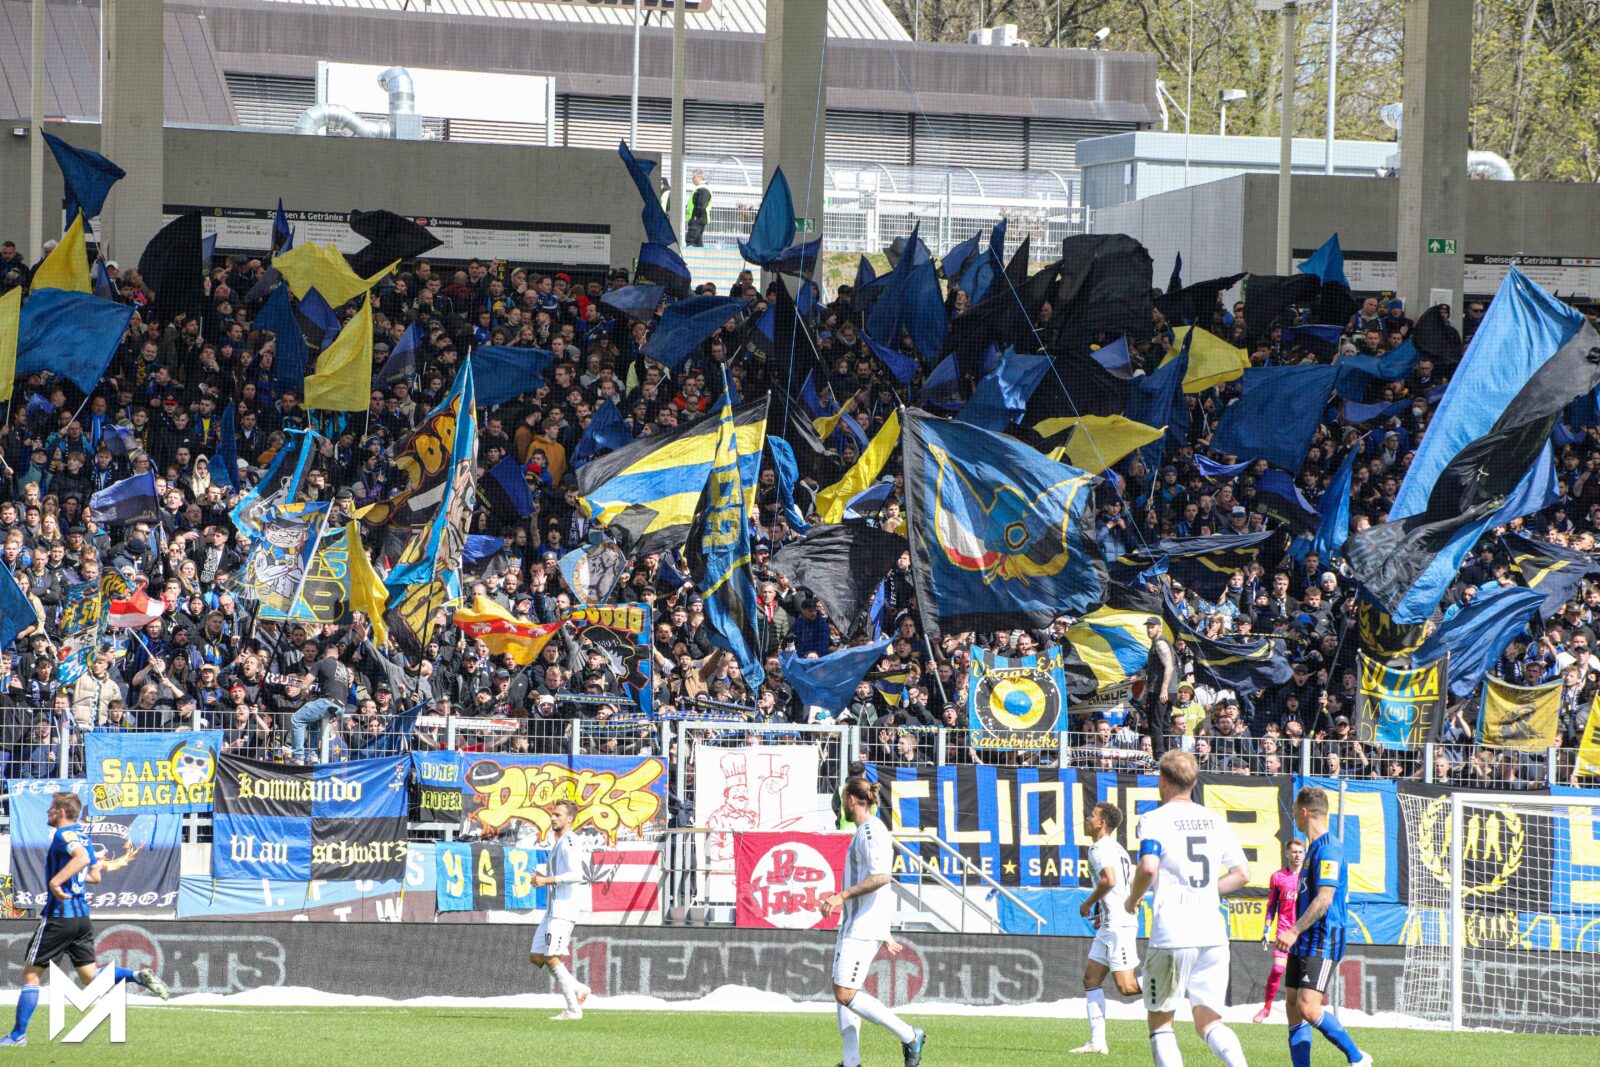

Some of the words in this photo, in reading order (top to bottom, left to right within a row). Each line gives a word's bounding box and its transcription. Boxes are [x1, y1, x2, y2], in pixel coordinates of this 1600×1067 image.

[267, 210, 298, 220] Spsen
[307, 212, 344, 221] Getränke
[1522, 257, 1558, 265] Getränke
[1361, 655, 1439, 697] ULTRA
[970, 730, 1059, 748] Saarbrücke
[1400, 725, 1427, 748] VIE
[102, 758, 174, 784] SAAR
[421, 761, 458, 782] HONEY
[121, 782, 216, 808] BAGAGE
[890, 779, 1161, 852] CLIQUE
[1174, 819, 1215, 831] SEEGERT
[311, 839, 408, 868] schwarz
[1186, 836, 1210, 888] 5
[892, 854, 993, 876] ANAILLE
[1228, 901, 1263, 915] BOYS
